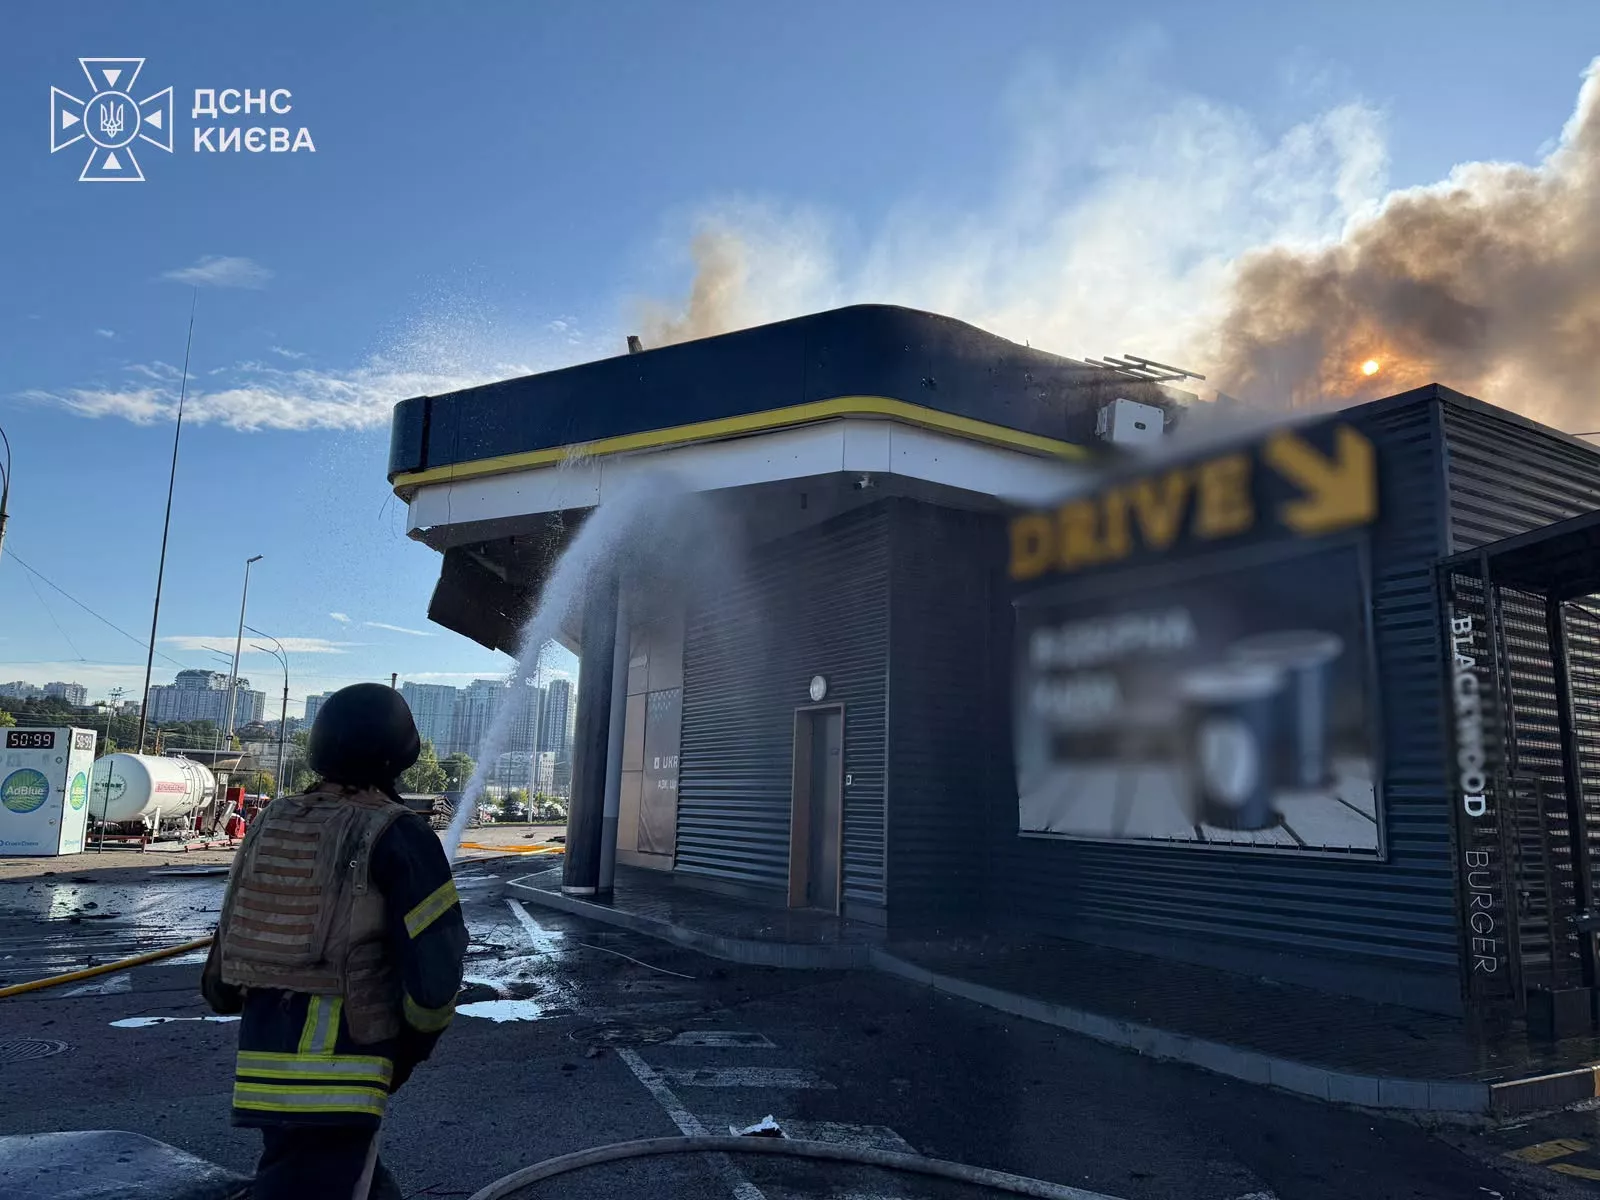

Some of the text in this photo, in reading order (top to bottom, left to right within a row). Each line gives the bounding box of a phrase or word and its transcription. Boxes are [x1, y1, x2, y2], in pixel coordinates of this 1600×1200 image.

[1010, 456, 1252, 580] DRIVE
[11, 733, 52, 747] 50:99
[6, 785, 45, 796] AdBlue
[1465, 851, 1497, 973] BURGER
